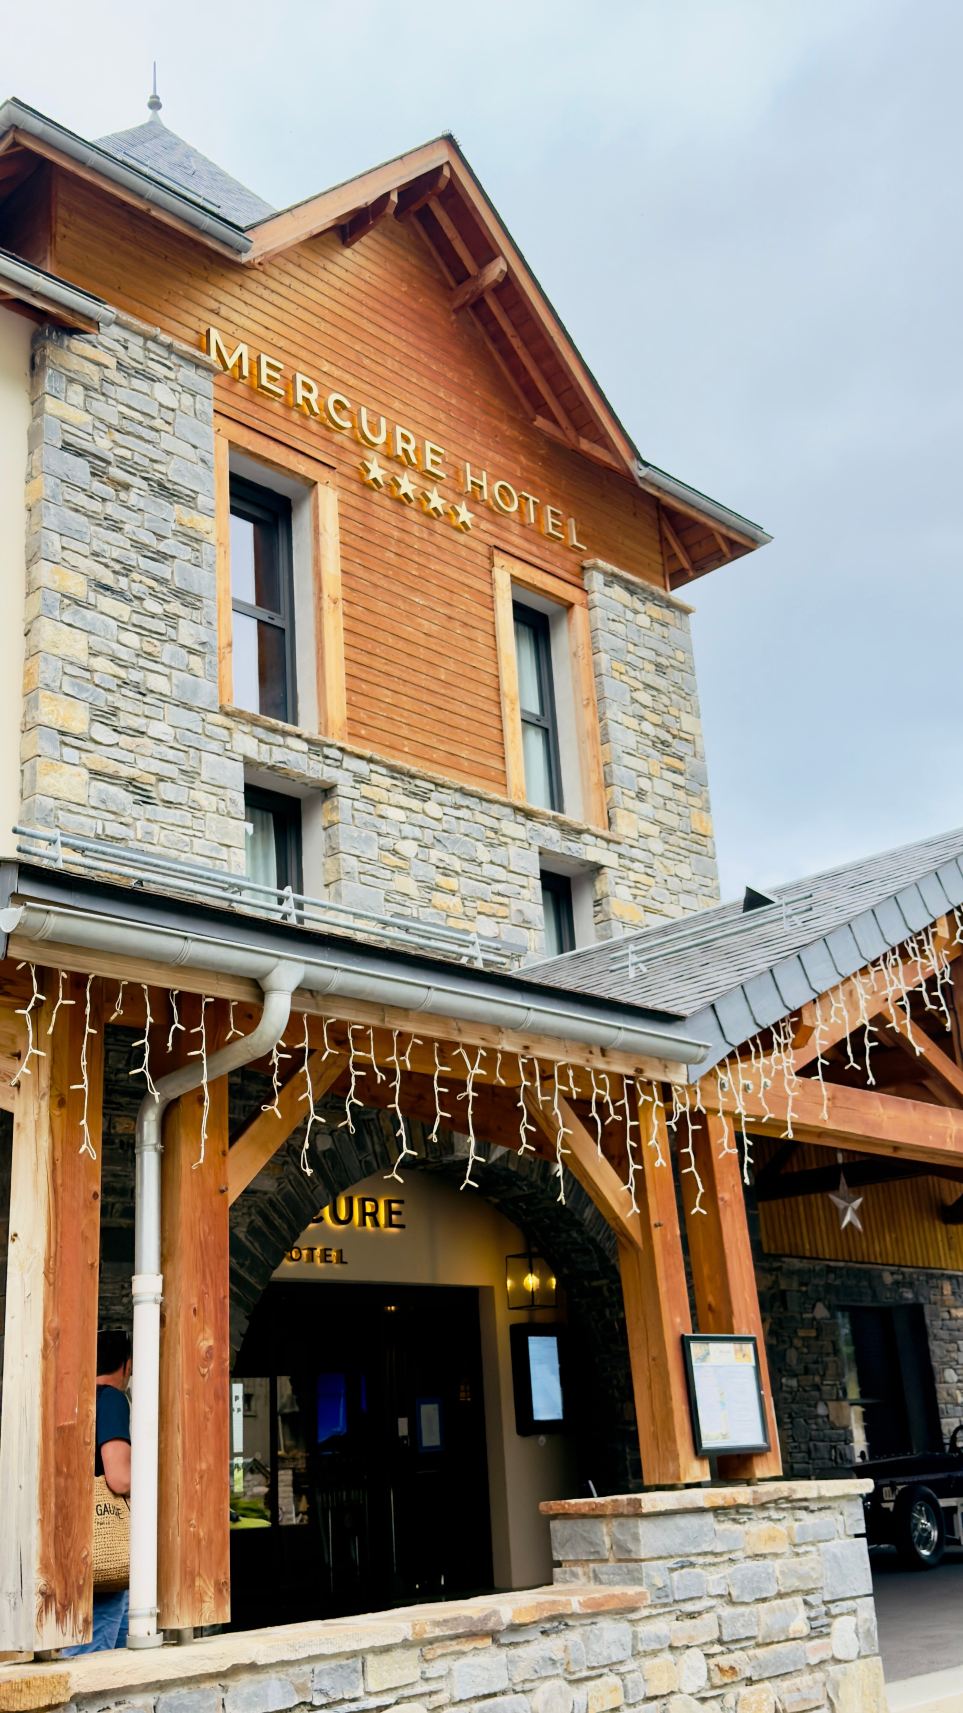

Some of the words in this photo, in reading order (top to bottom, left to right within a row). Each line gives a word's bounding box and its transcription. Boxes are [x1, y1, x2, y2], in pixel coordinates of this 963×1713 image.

[206, 327, 446, 479] MERCURE
[464, 462, 587, 551] HOTEL
[312, 1196, 406, 1229] URE
[288, 1247, 348, 1264] OTEL
